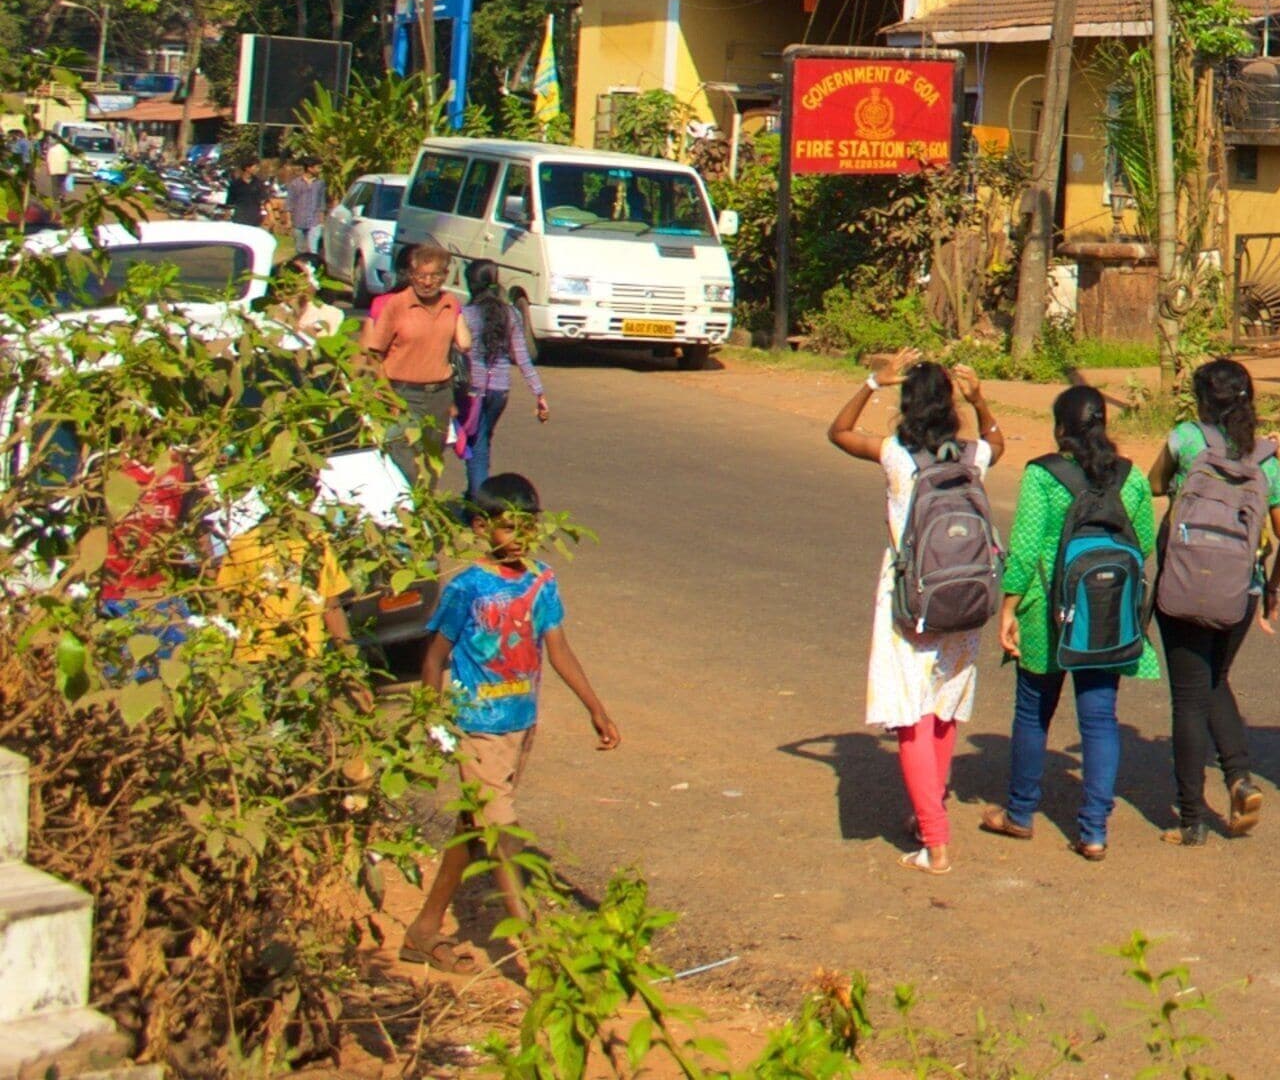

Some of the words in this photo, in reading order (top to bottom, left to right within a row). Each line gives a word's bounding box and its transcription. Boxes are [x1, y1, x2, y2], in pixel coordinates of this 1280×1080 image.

[801, 65, 893, 110] GOVERNMENT
[894, 68, 913, 85] OF
[913, 76, 941, 107] GOA
[795, 139, 834, 158] FIRE
[838, 139, 905, 159] STATION
